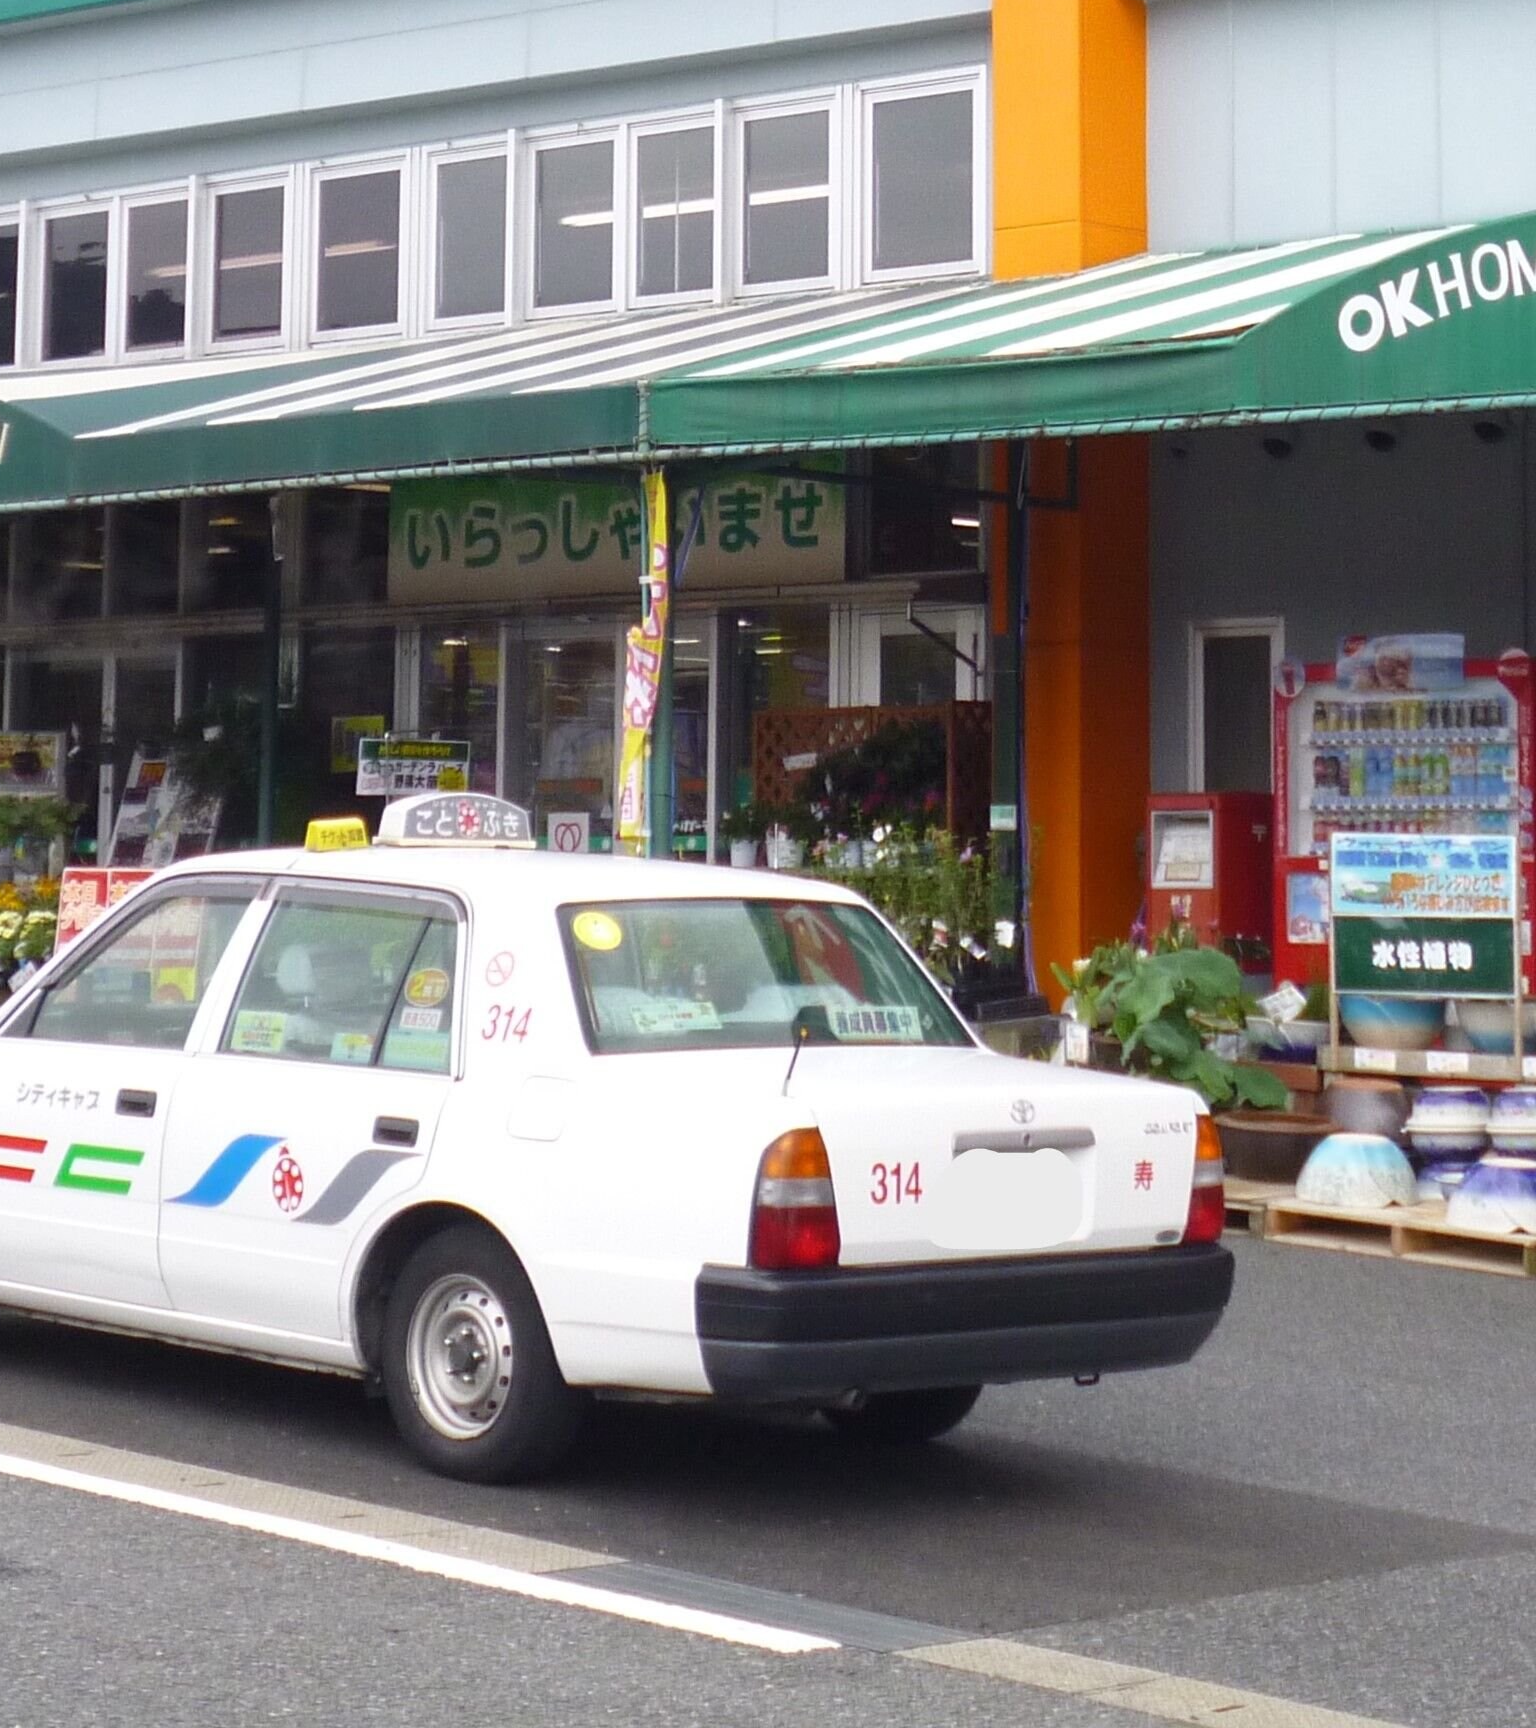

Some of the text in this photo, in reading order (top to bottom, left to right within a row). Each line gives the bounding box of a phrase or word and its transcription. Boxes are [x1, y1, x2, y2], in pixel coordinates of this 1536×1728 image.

[481, 1004, 532, 1043] 314
[870, 1161, 923, 1204] 314
[1134, 1159, 1153, 1191] 寿
